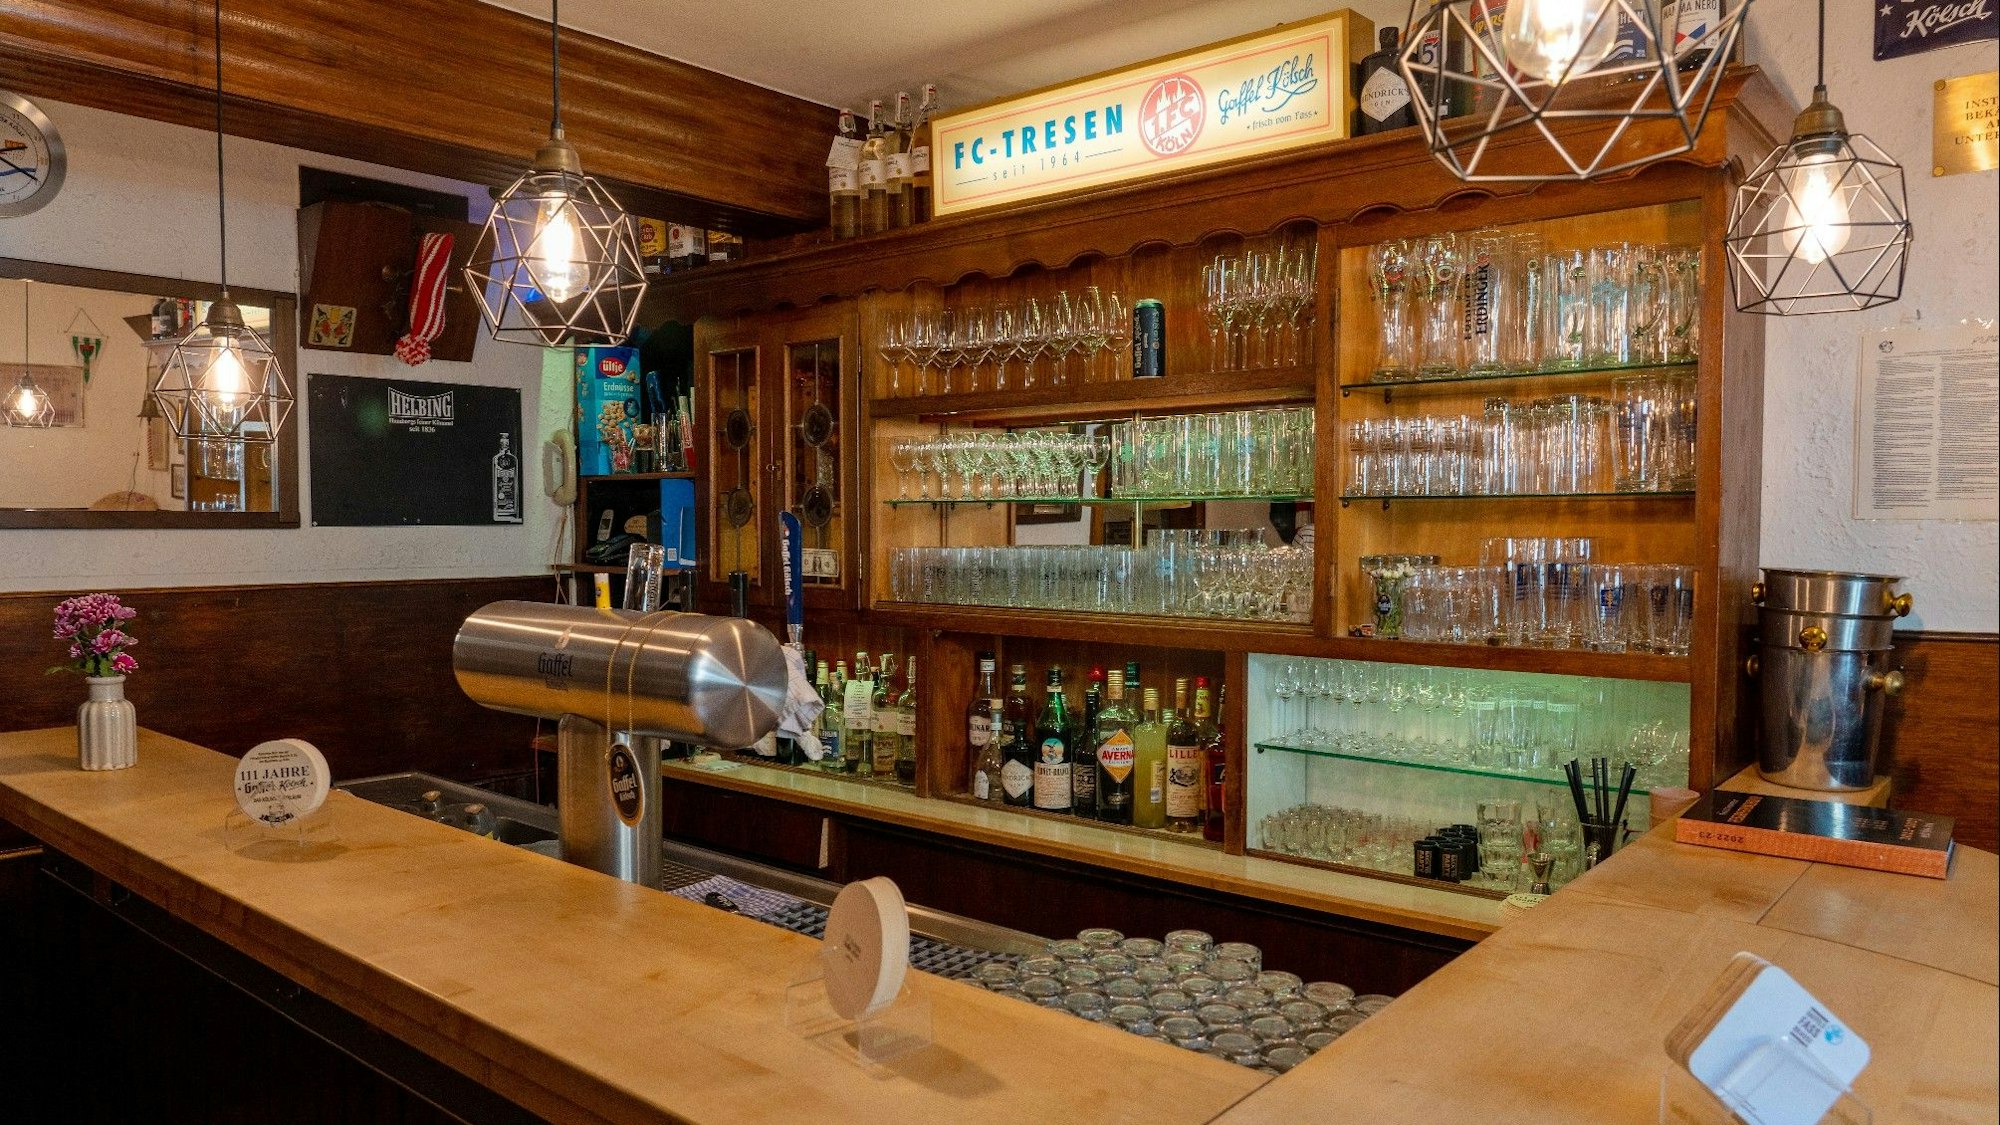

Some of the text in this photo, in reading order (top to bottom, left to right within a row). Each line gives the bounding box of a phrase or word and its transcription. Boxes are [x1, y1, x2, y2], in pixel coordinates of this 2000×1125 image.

[1218, 53, 1317, 126] Gaffel Kölsch
[954, 103, 1123, 170] FC-TRESEN
[1155, 127, 1194, 152] KÖLN
[993, 150, 1080, 181] seit 1964
[1475, 263, 1490, 335] ERDINGER
[602, 360, 623, 372] ültje
[603, 382, 634, 393] Erdnüsse
[390, 390, 452, 418] HELBING
[537, 652, 573, 678] Gaffel
[262, 765, 310, 779] JAHRE
[612, 773, 638, 794] Gaffel
[1699, 831, 1745, 844] 2022-23
